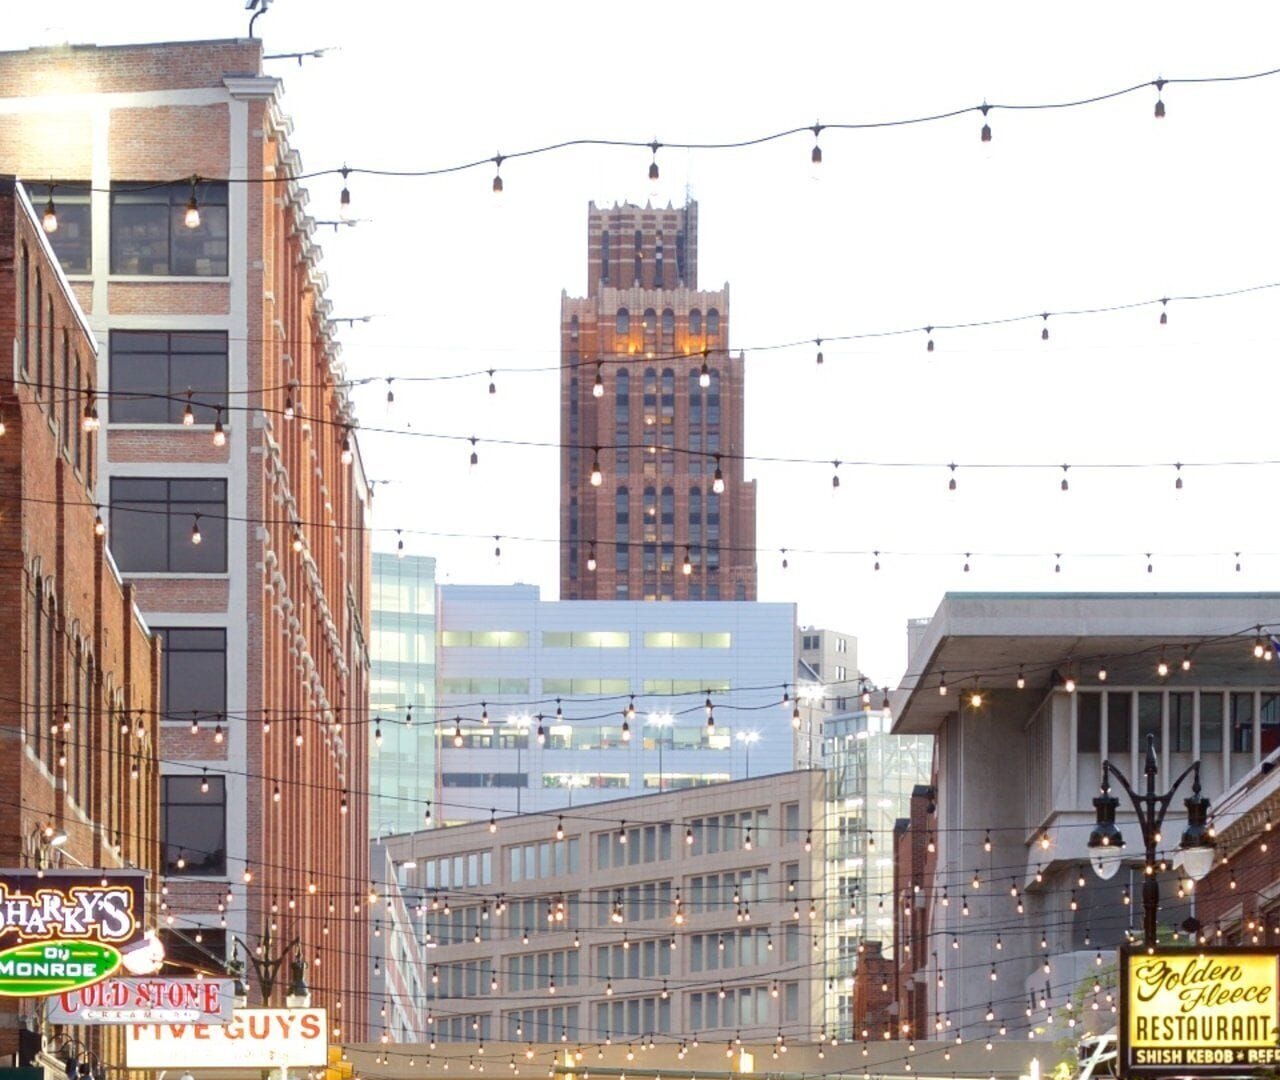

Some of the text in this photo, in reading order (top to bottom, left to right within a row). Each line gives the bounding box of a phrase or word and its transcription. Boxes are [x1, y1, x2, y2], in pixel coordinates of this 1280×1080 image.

[1135, 958, 1243, 1002] Golden
[135, 979, 222, 1015] STONE
[1178, 982, 1272, 1013] Fleece
[133, 1014, 321, 1041] FIVE GUYS
[1137, 1015, 1271, 1041] RESTAURANT
[1136, 1049, 1183, 1064] SHISH
[1186, 1049, 1234, 1063] KEBOB
